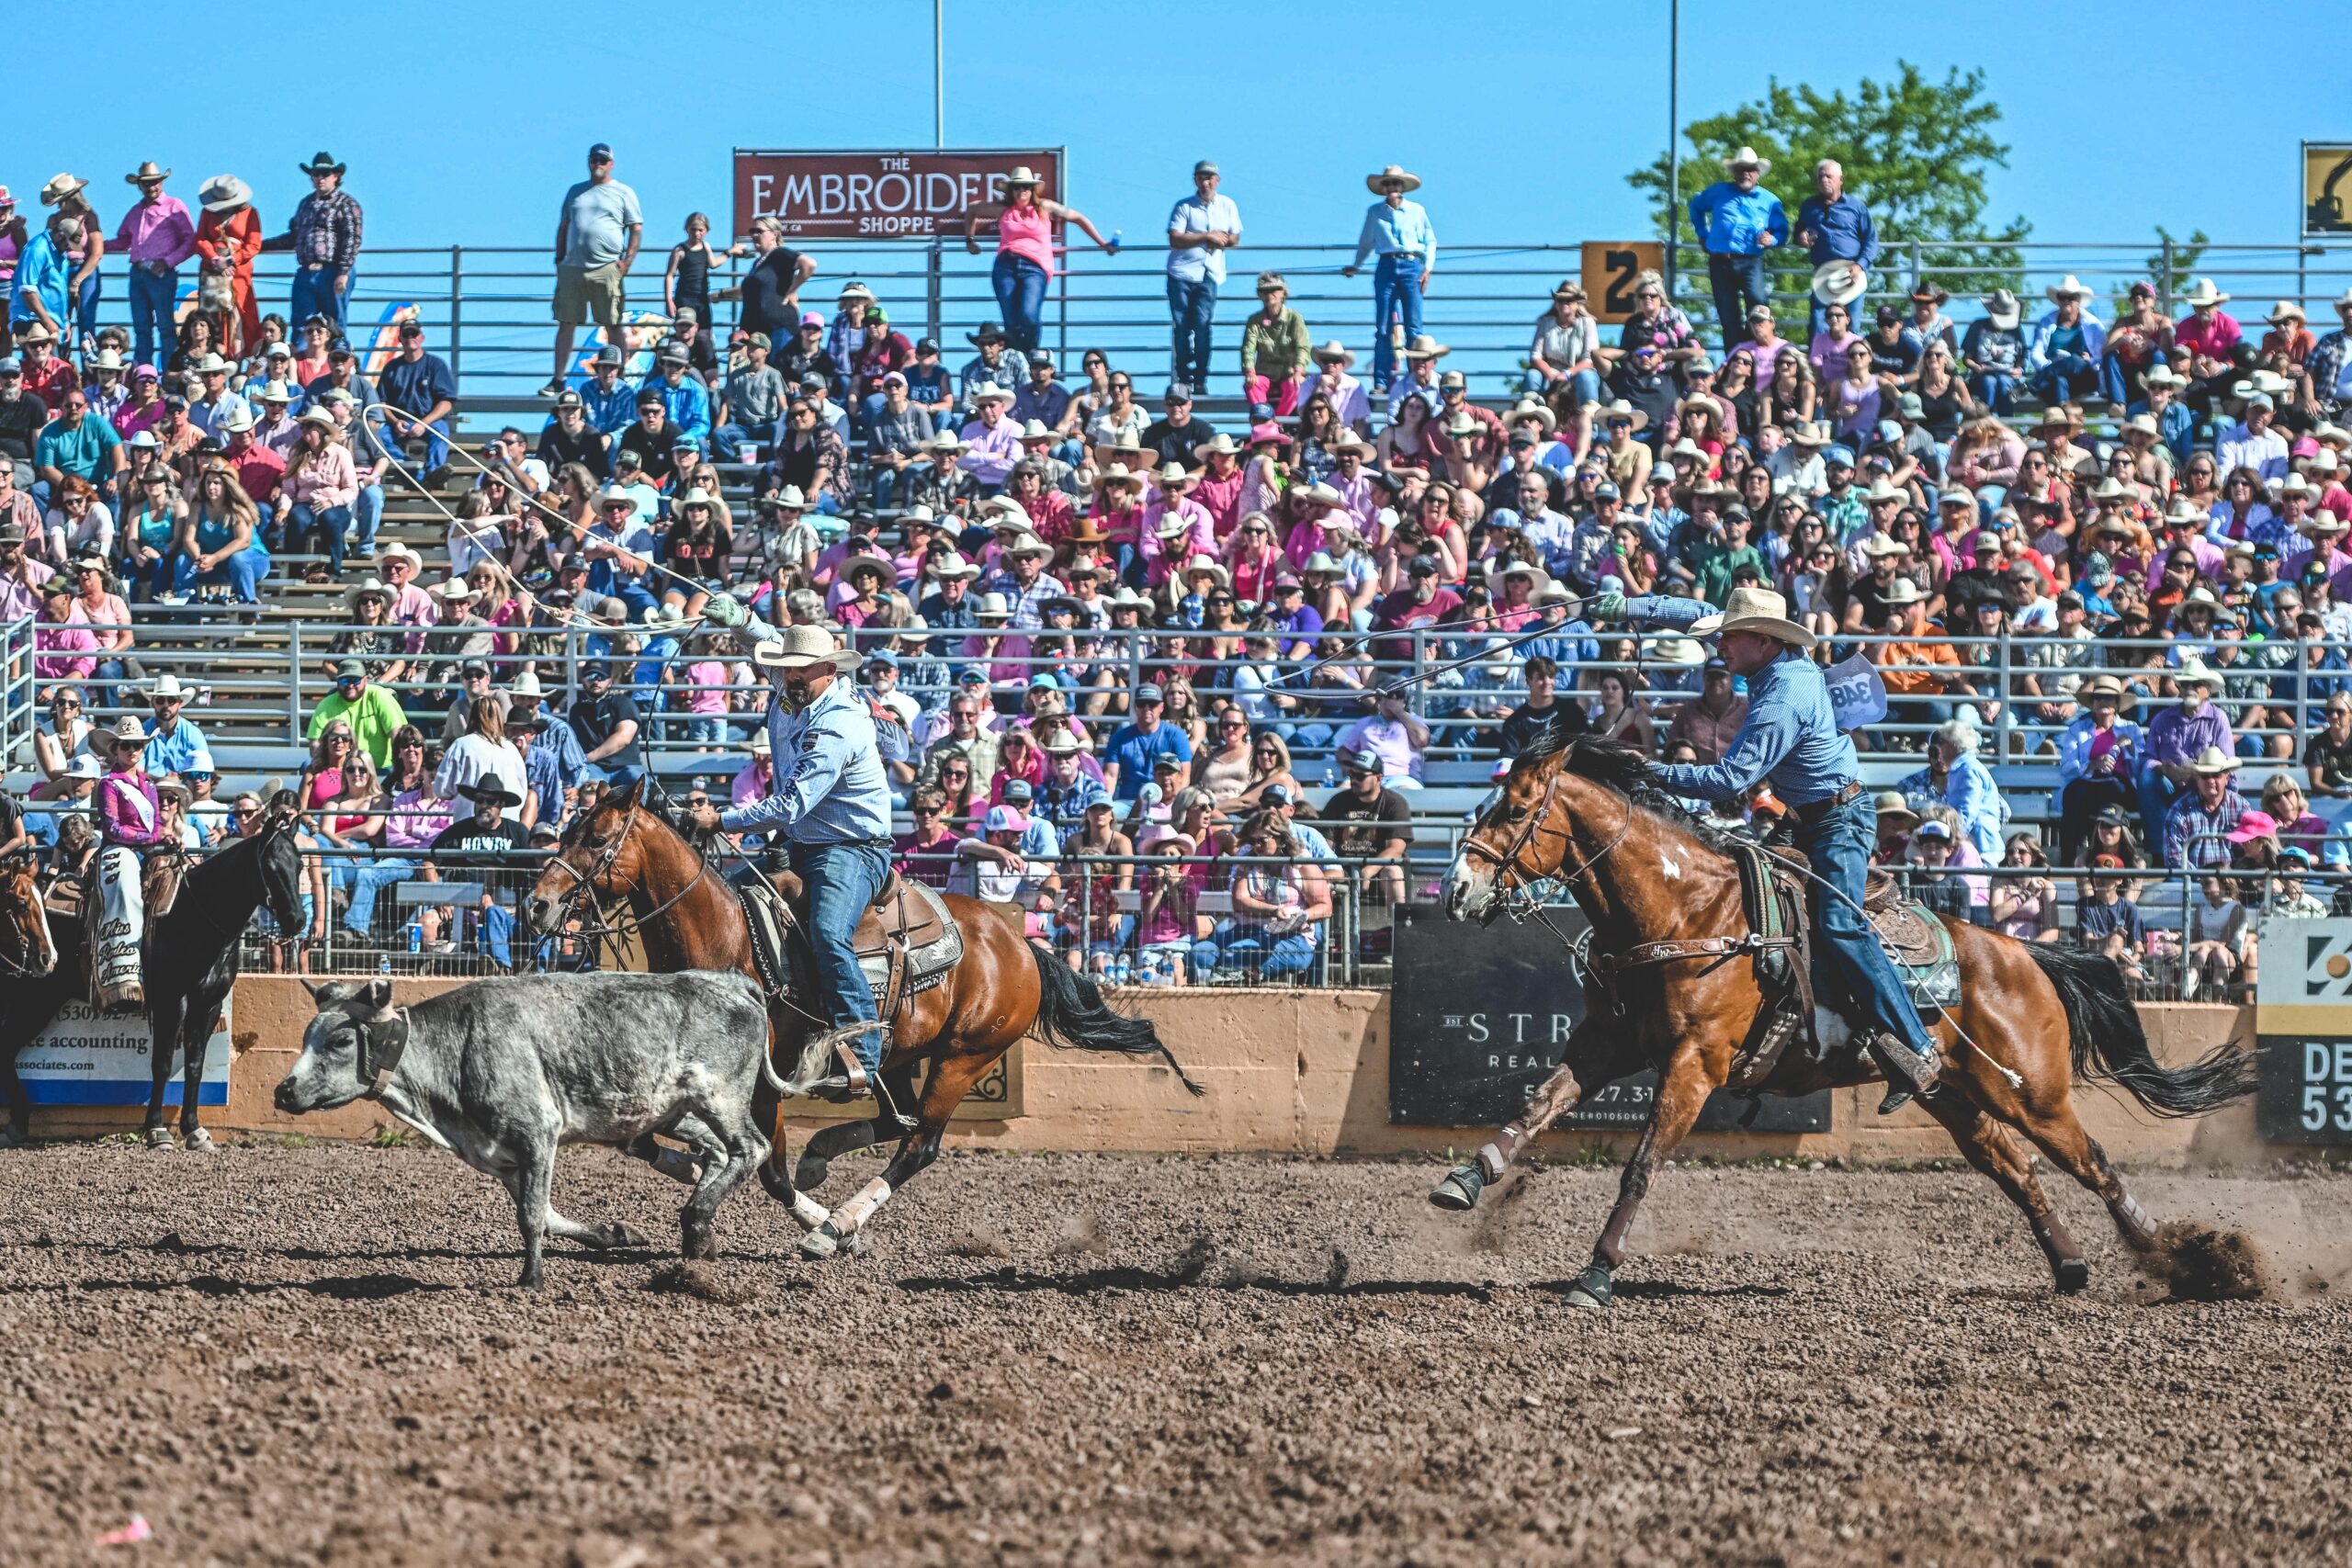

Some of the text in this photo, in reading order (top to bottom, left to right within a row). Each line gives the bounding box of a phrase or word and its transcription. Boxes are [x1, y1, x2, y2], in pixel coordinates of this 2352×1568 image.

[881, 158, 910, 171] THE
[752, 173, 1042, 219] EMBROIDER
[858, 216, 934, 233] SHOPPE
[1606, 250, 1637, 313] 2
[461, 836, 513, 851] HOWDY
[100, 918, 131, 942] Miss
[98, 941, 137, 965] Rodeo
[101, 962, 141, 985] Americ
[1467, 1013, 1571, 1043] STR
[50, 1032, 149, 1055] accounting
[1489, 1055, 1555, 1069] REAL
